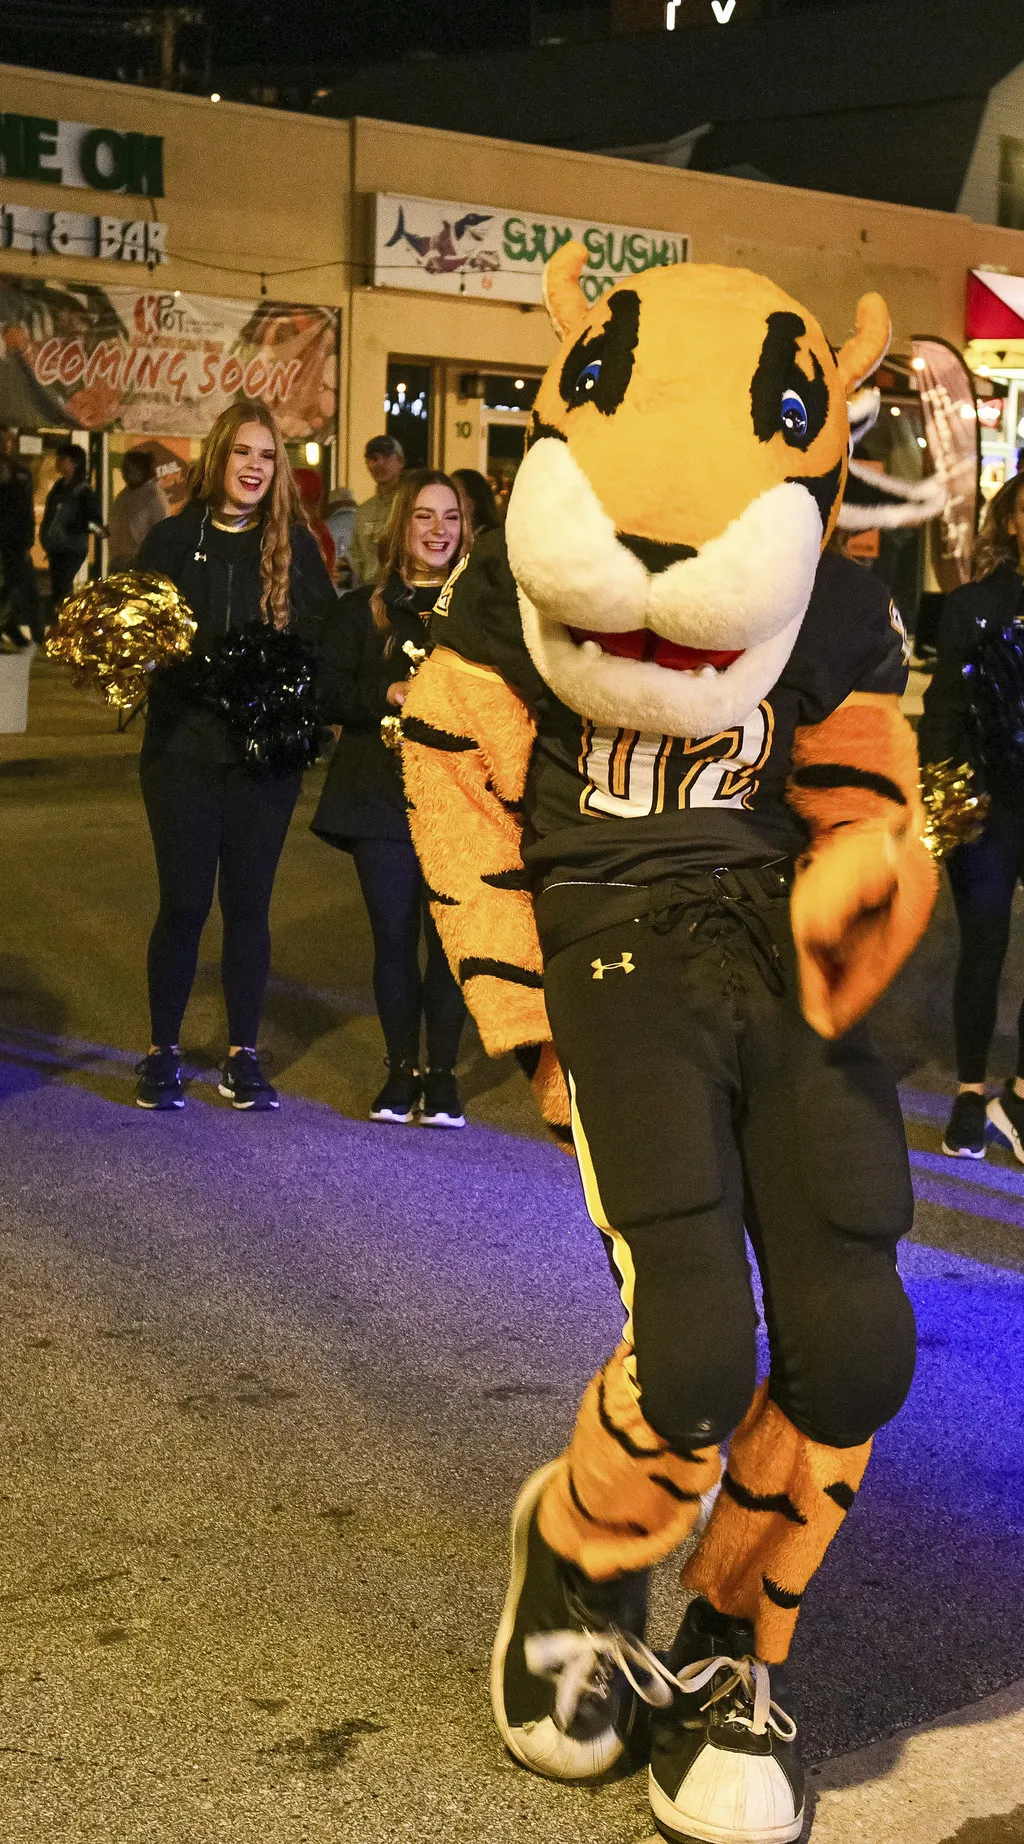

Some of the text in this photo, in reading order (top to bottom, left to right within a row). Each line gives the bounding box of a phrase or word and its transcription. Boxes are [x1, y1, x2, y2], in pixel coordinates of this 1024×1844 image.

[100, 216, 169, 264] BAR
[583, 228, 689, 274] SUSHI
[34, 337, 301, 404] COMING SOON
[455, 421, 472, 438] 10
